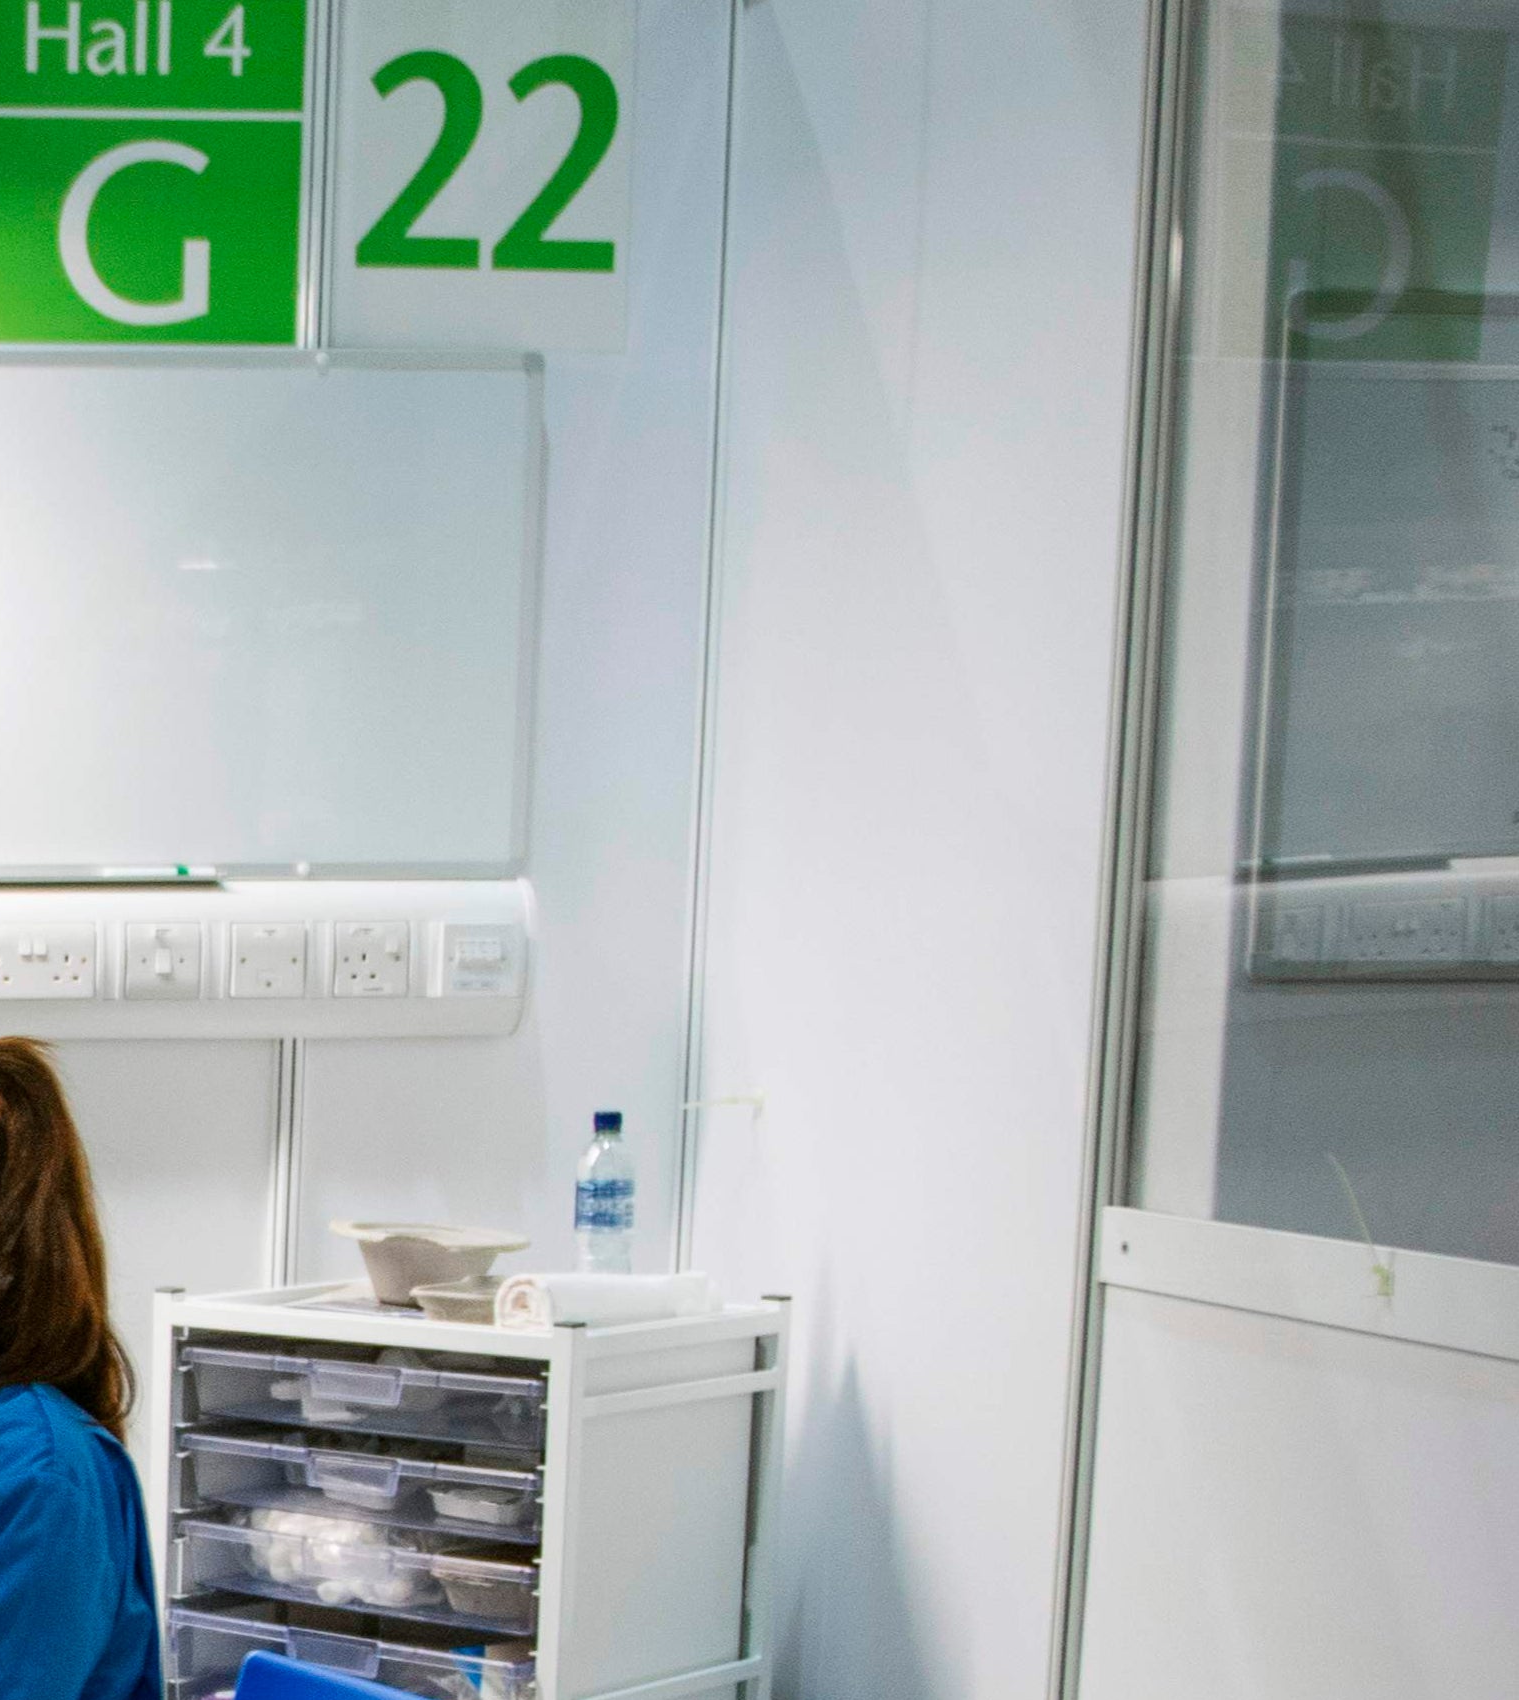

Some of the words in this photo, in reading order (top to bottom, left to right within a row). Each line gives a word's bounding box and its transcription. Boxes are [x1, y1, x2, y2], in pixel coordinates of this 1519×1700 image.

[25, 0, 171, 76] Hall
[203, 3, 252, 77] 4
[57, 138, 210, 326] G
[355, 48, 619, 272] 22
